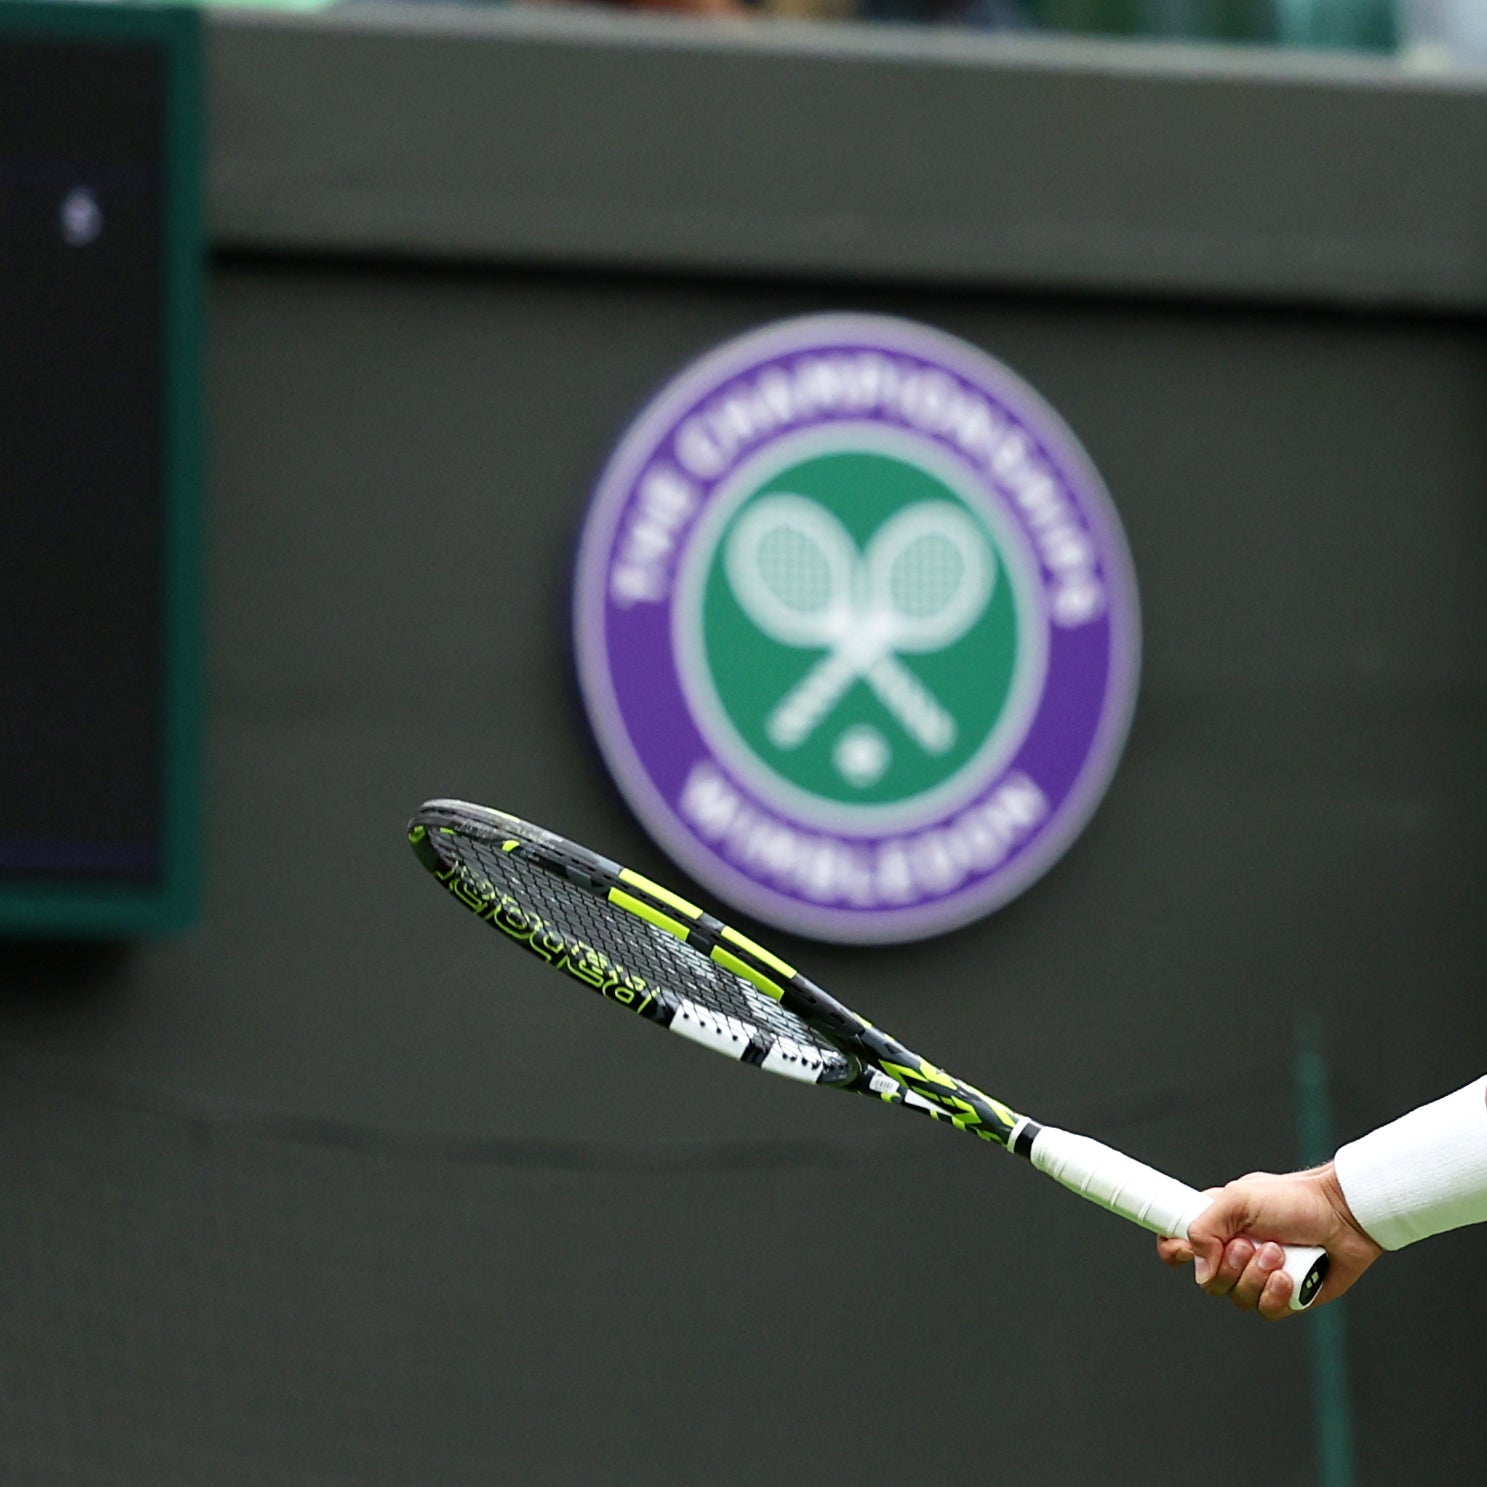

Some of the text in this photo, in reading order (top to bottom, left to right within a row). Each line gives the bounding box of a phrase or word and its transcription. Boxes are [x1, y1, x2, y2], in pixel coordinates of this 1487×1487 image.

[611, 354, 1102, 627] THE CHAMPIONSHIPS
[680, 758, 1048, 905] WIMBLEDON
